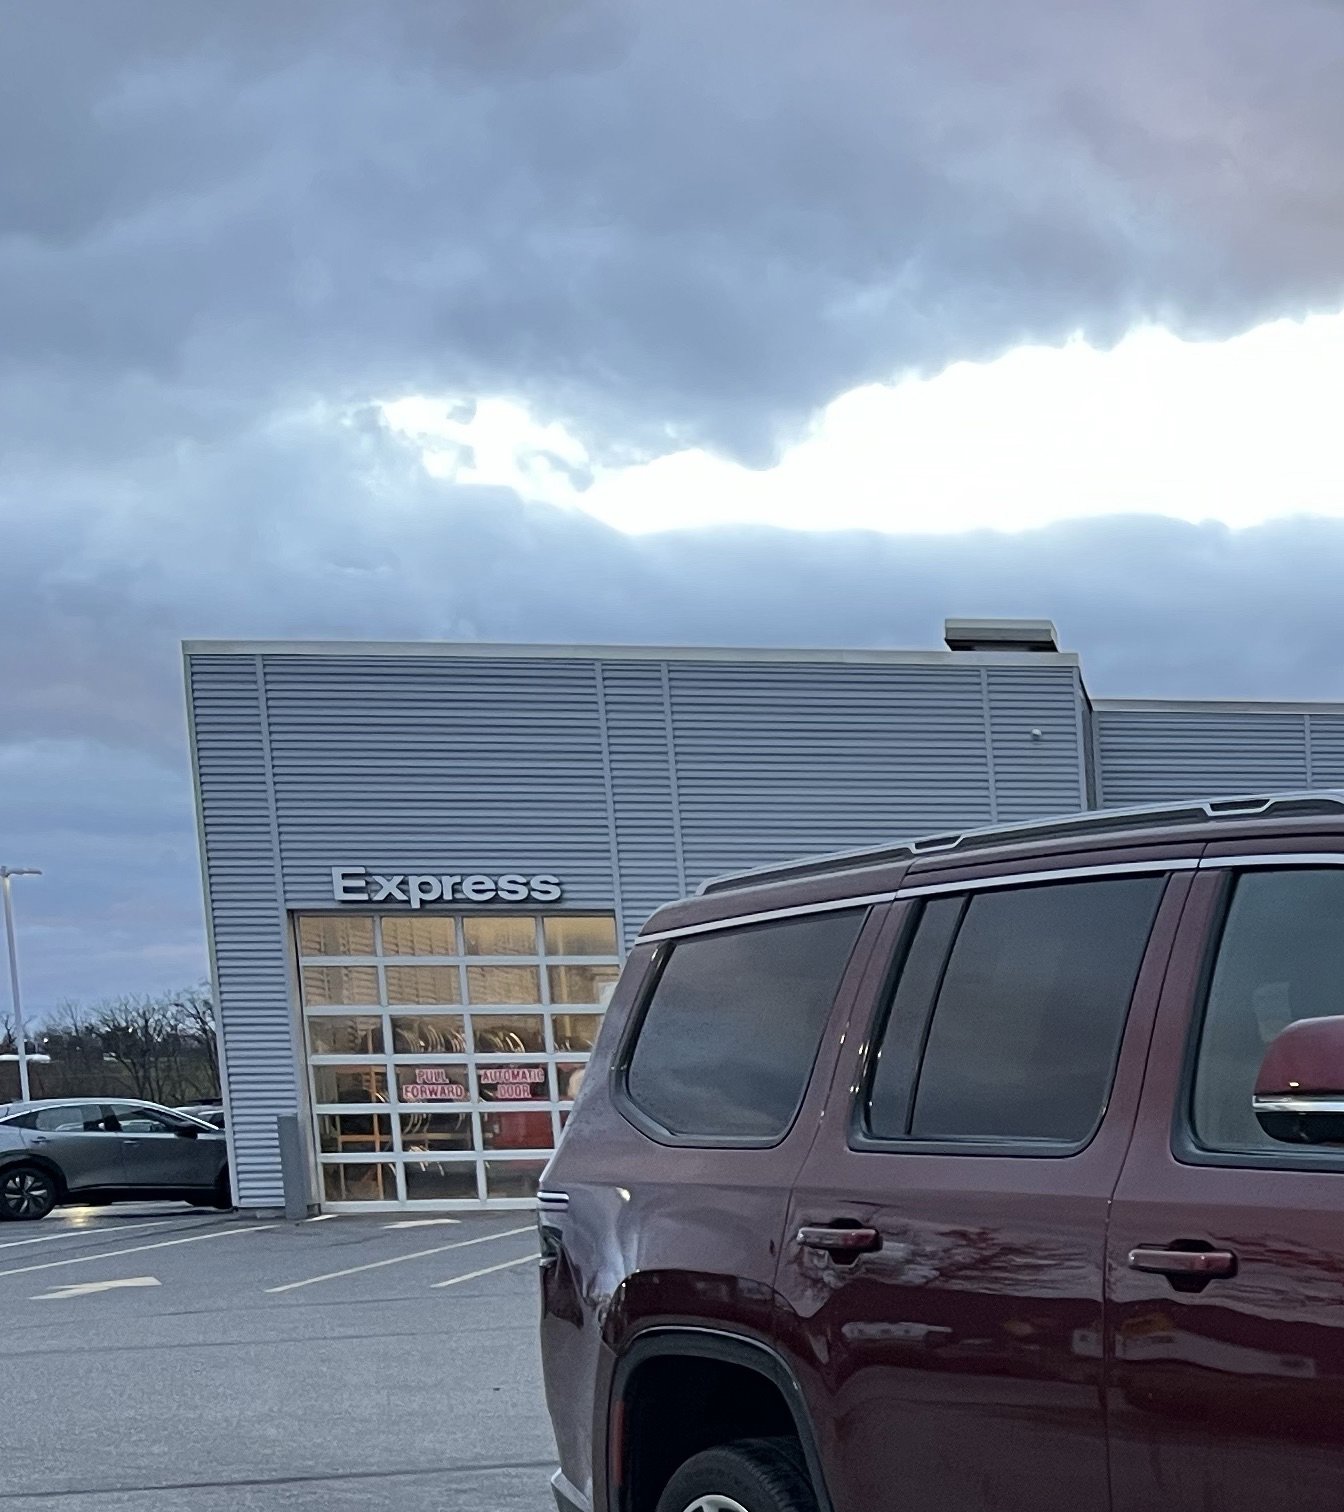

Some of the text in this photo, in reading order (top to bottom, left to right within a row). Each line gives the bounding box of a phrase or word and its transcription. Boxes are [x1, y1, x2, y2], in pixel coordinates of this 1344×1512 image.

[331, 866, 562, 909] Express
[416, 1069, 449, 1084] PULL
[481, 1069, 545, 1084] AUTOMATIC
[402, 1084, 465, 1099] FORWARD
[497, 1084, 532, 1099] DOOR
